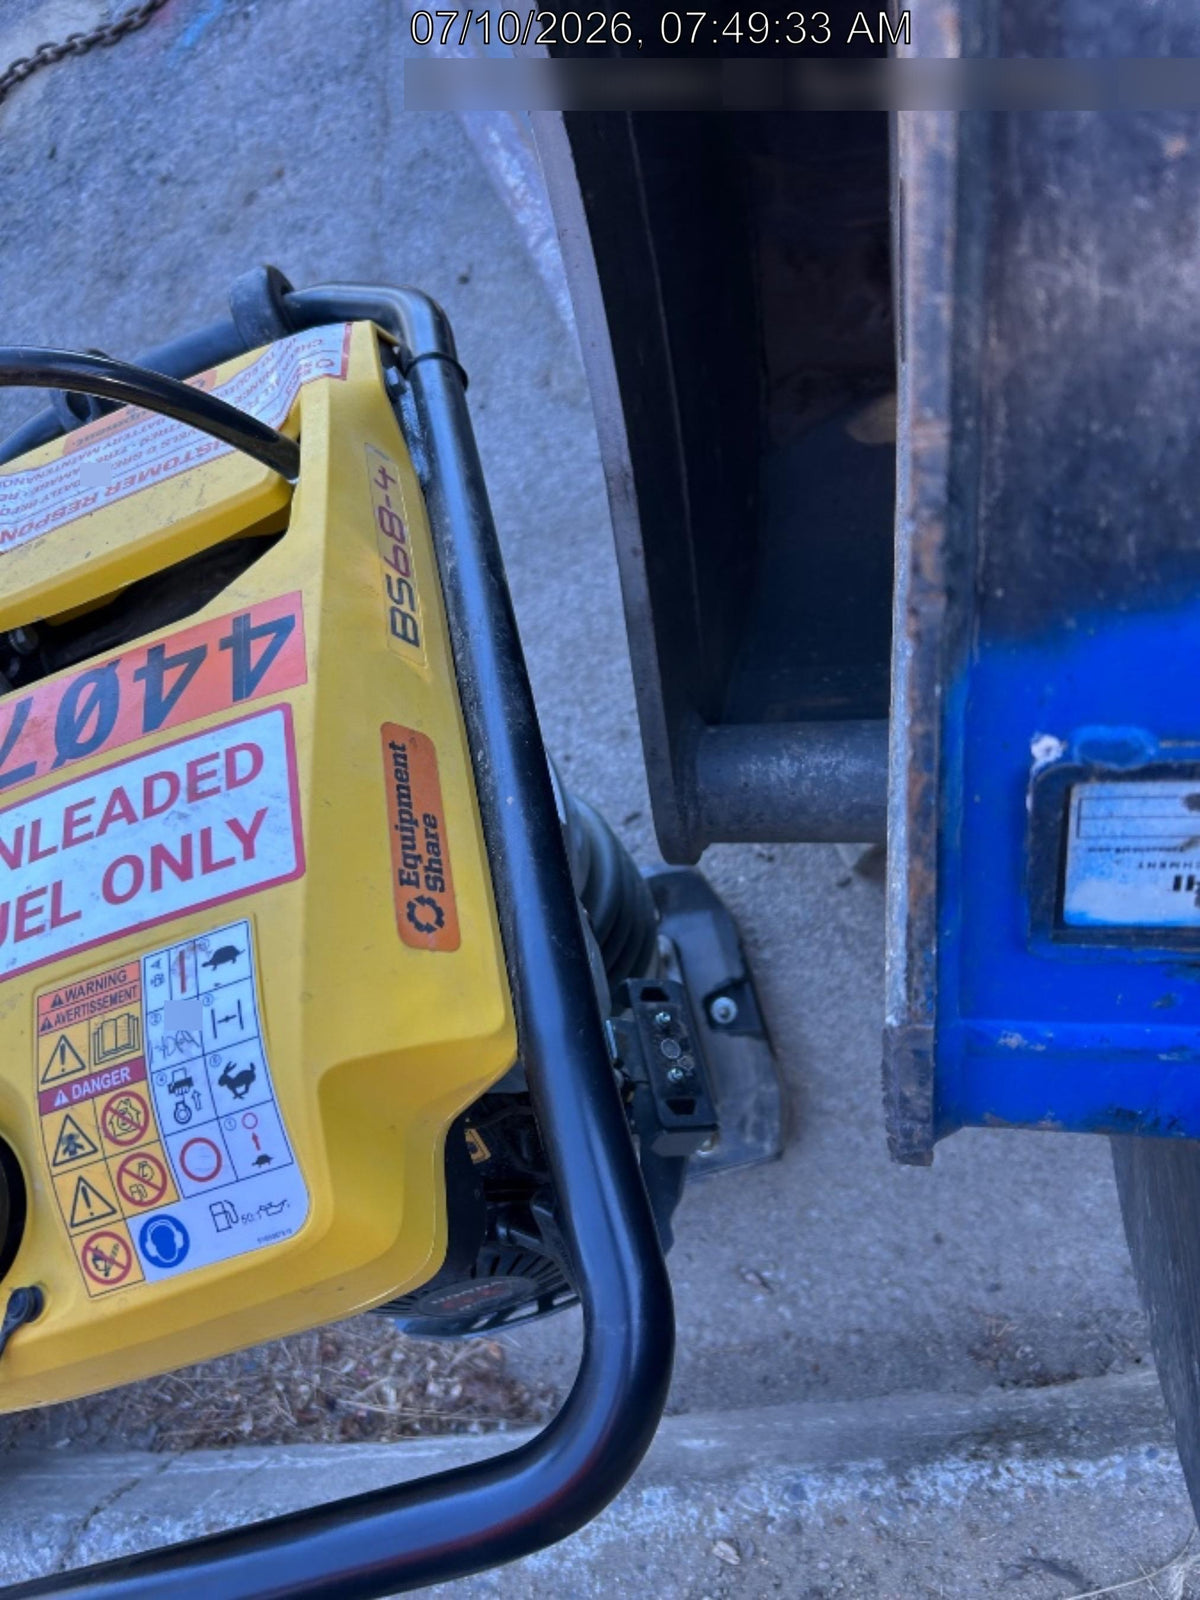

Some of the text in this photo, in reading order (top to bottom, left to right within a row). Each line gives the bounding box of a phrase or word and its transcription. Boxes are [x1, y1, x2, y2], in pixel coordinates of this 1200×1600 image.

[374, 465, 420, 648] BS68-4
[389, 740, 420, 889] Equipment
[422, 812, 445, 893] Share
[102, 806, 269, 905] ONLY
[54, 985, 138, 1026] AVERTISSEMENT
[64, 969, 127, 1001] WARNING
[71, 1066, 132, 1100] DANGER
